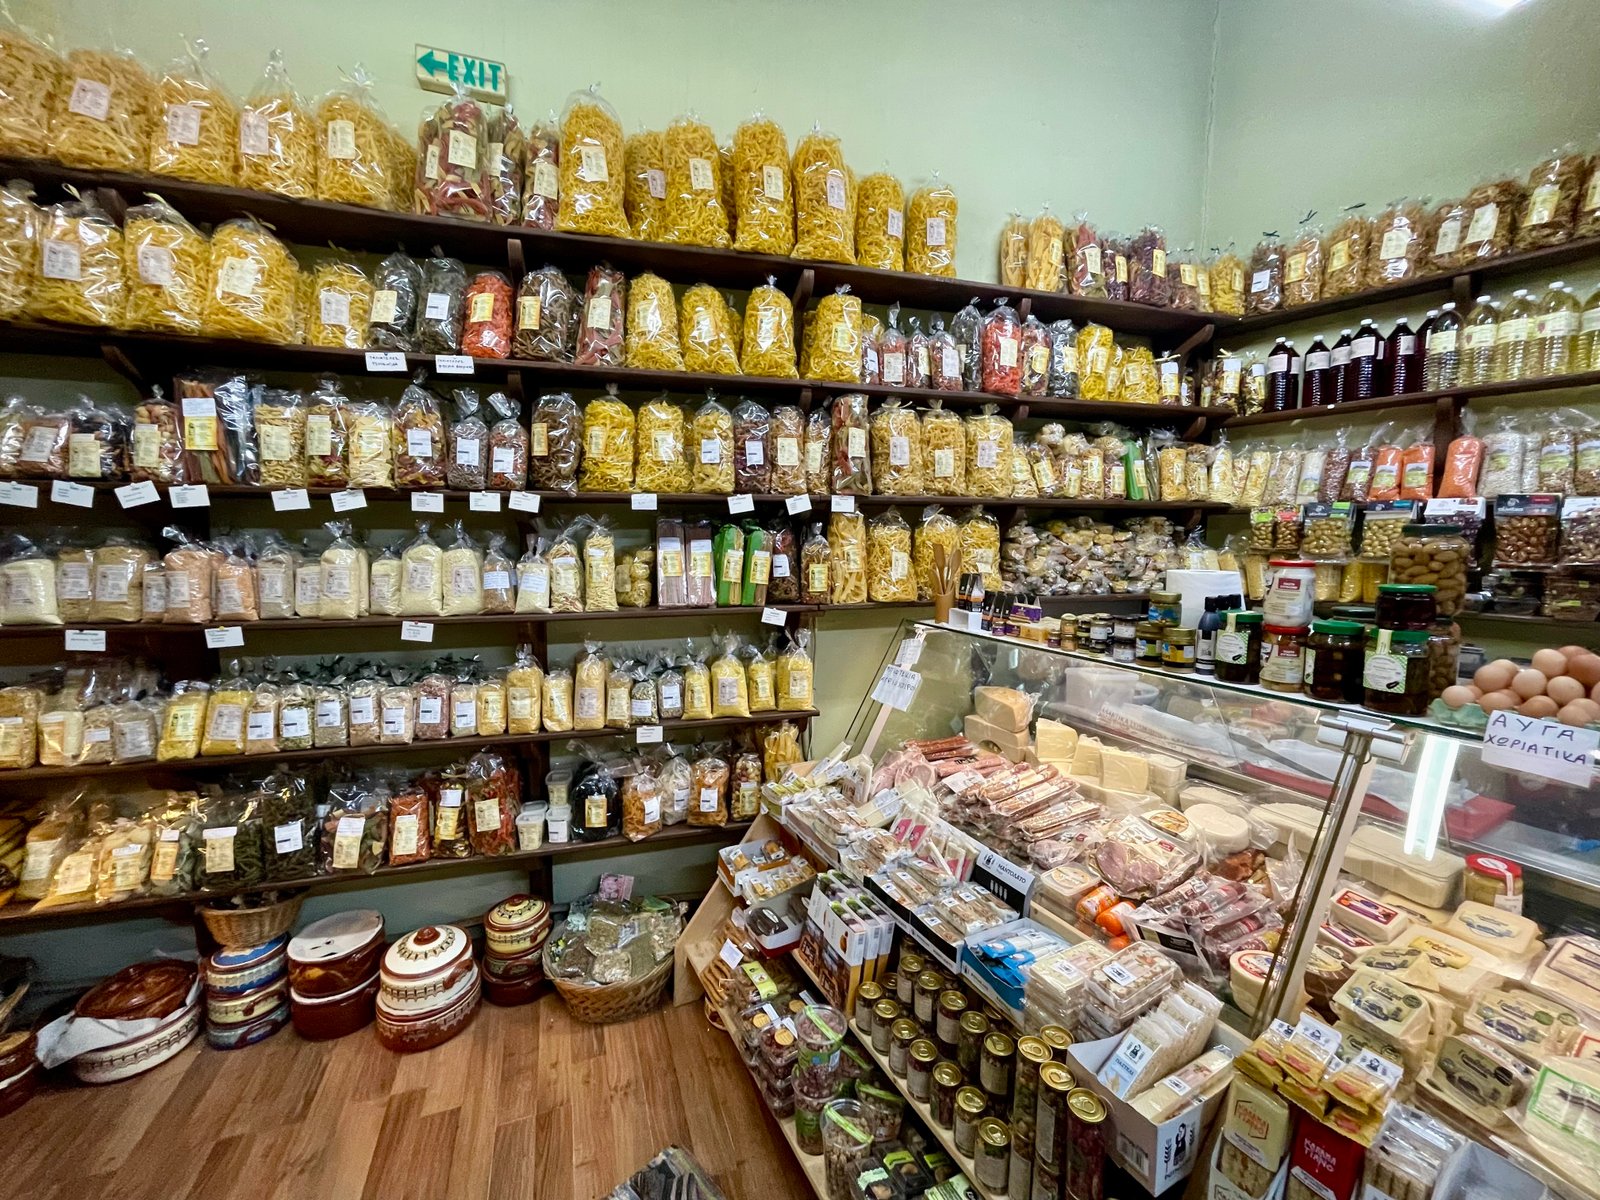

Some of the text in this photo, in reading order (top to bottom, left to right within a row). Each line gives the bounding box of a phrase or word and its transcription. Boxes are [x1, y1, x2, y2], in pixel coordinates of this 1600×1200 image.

[448, 51, 501, 92] EXIT
[1492, 713, 1575, 741] ΑΥΓΑ
[1484, 733, 1587, 765] ΧΩΡΙΑΤΙΚΑ
[998, 863, 1027, 884] ΜΑΝΤΟΛΑΤΟ
